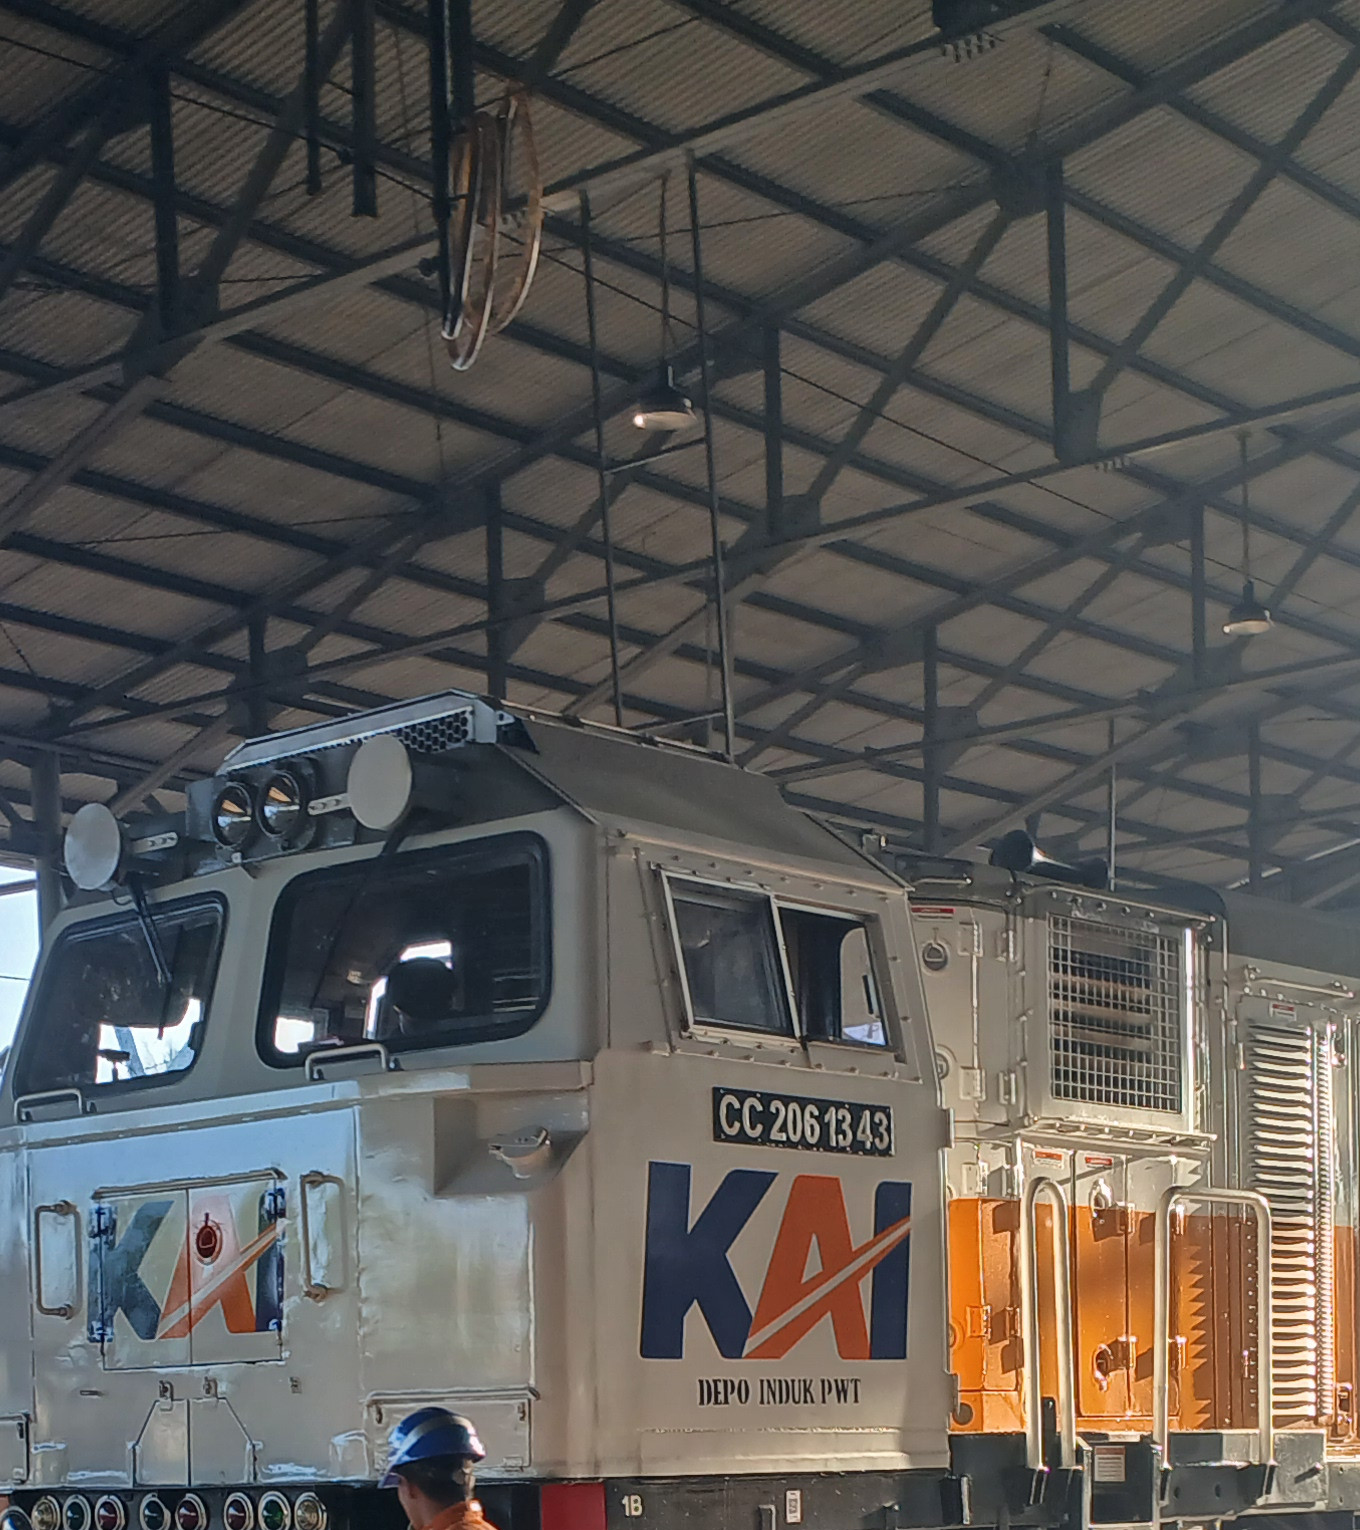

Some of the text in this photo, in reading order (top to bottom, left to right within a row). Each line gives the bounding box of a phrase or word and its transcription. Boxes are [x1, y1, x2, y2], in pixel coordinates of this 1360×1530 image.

[719, 1094, 763, 1138] CC
[770, 1100, 820, 1144] 206
[87, 1187, 286, 1342] KAI
[640, 1161, 912, 1359] KAI
[698, 1379, 861, 1405] DEPO INDUK PWT
[621, 1494, 643, 1517] 1B
